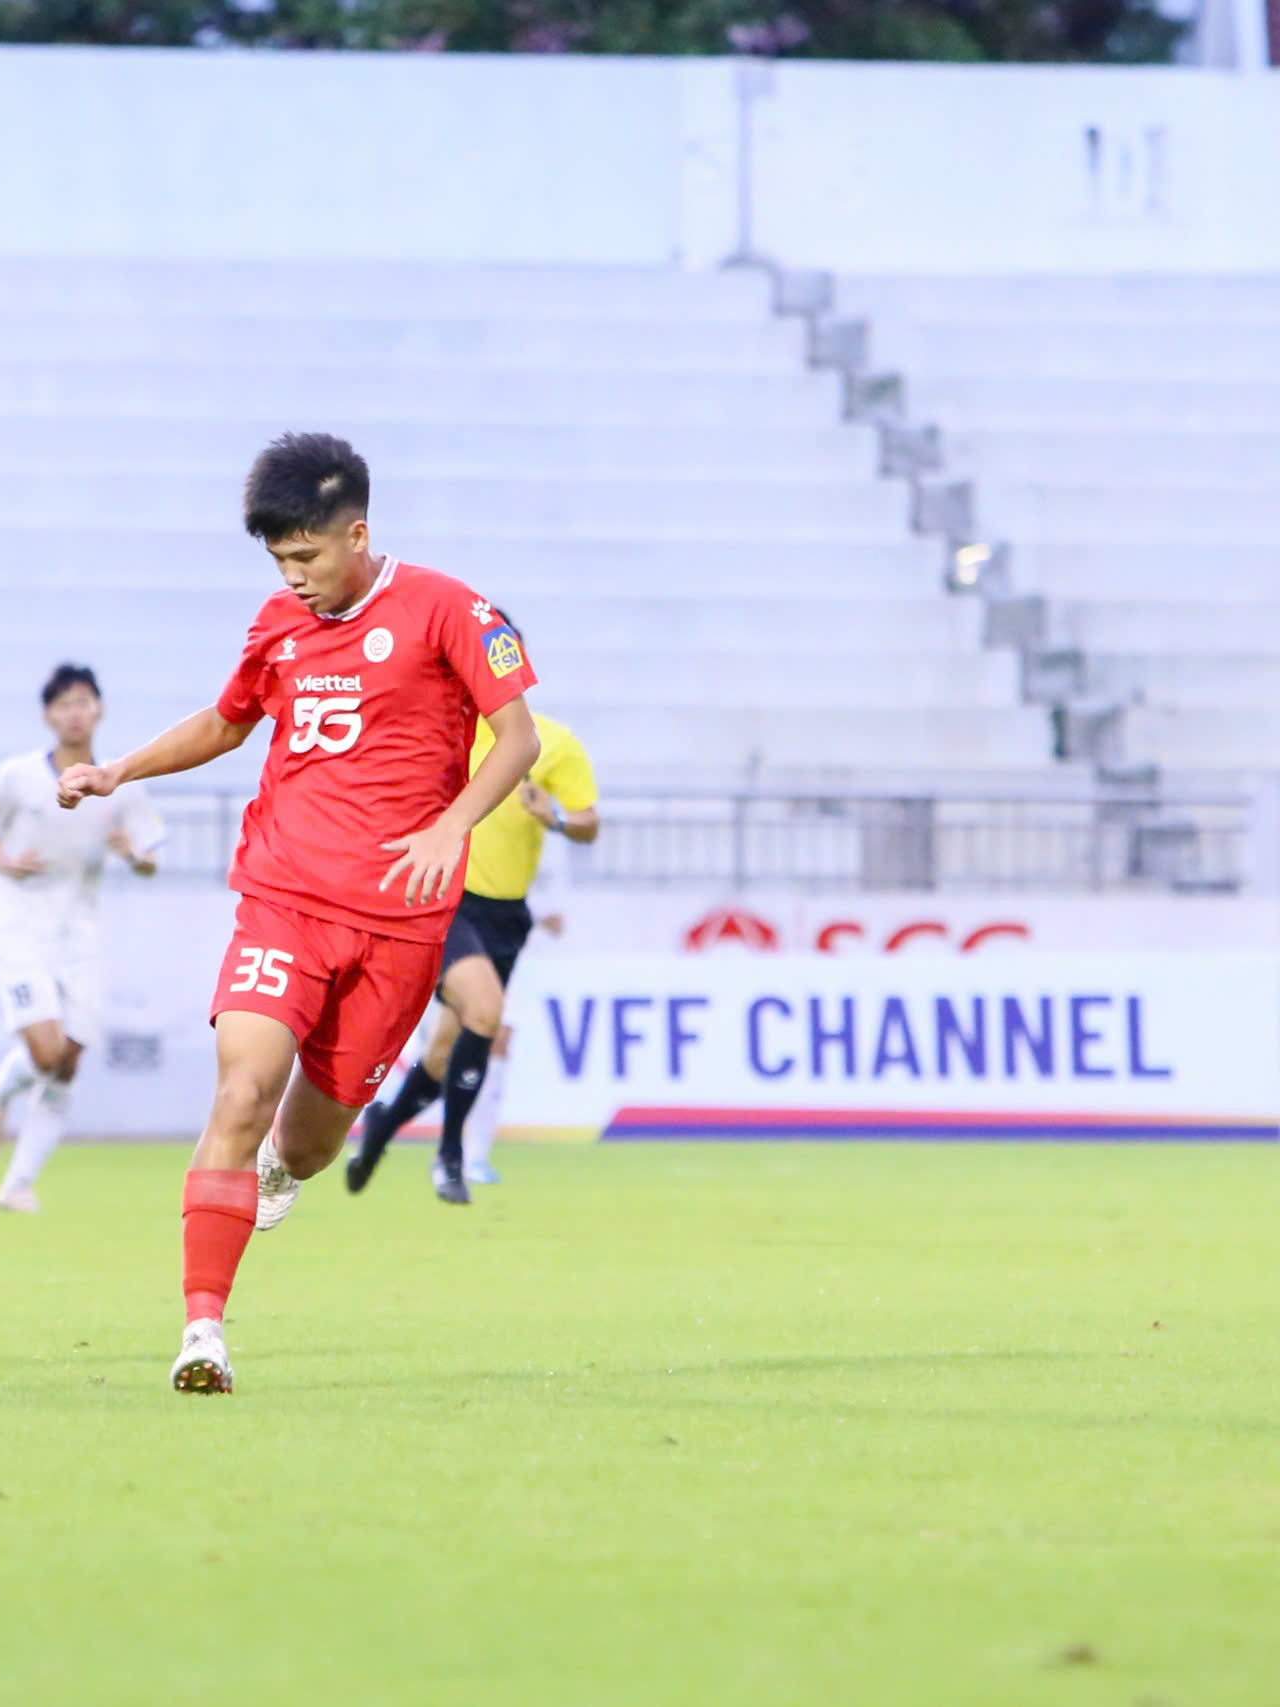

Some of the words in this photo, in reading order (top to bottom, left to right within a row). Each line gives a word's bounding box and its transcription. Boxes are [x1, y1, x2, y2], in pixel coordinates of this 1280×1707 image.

[294, 674, 363, 692] viettel
[491, 649, 520, 673] TSN
[288, 697, 363, 754] 5G
[229, 947, 295, 998] 35
[545, 996, 710, 1078] VFF
[746, 996, 1173, 1079] CHANNEL
